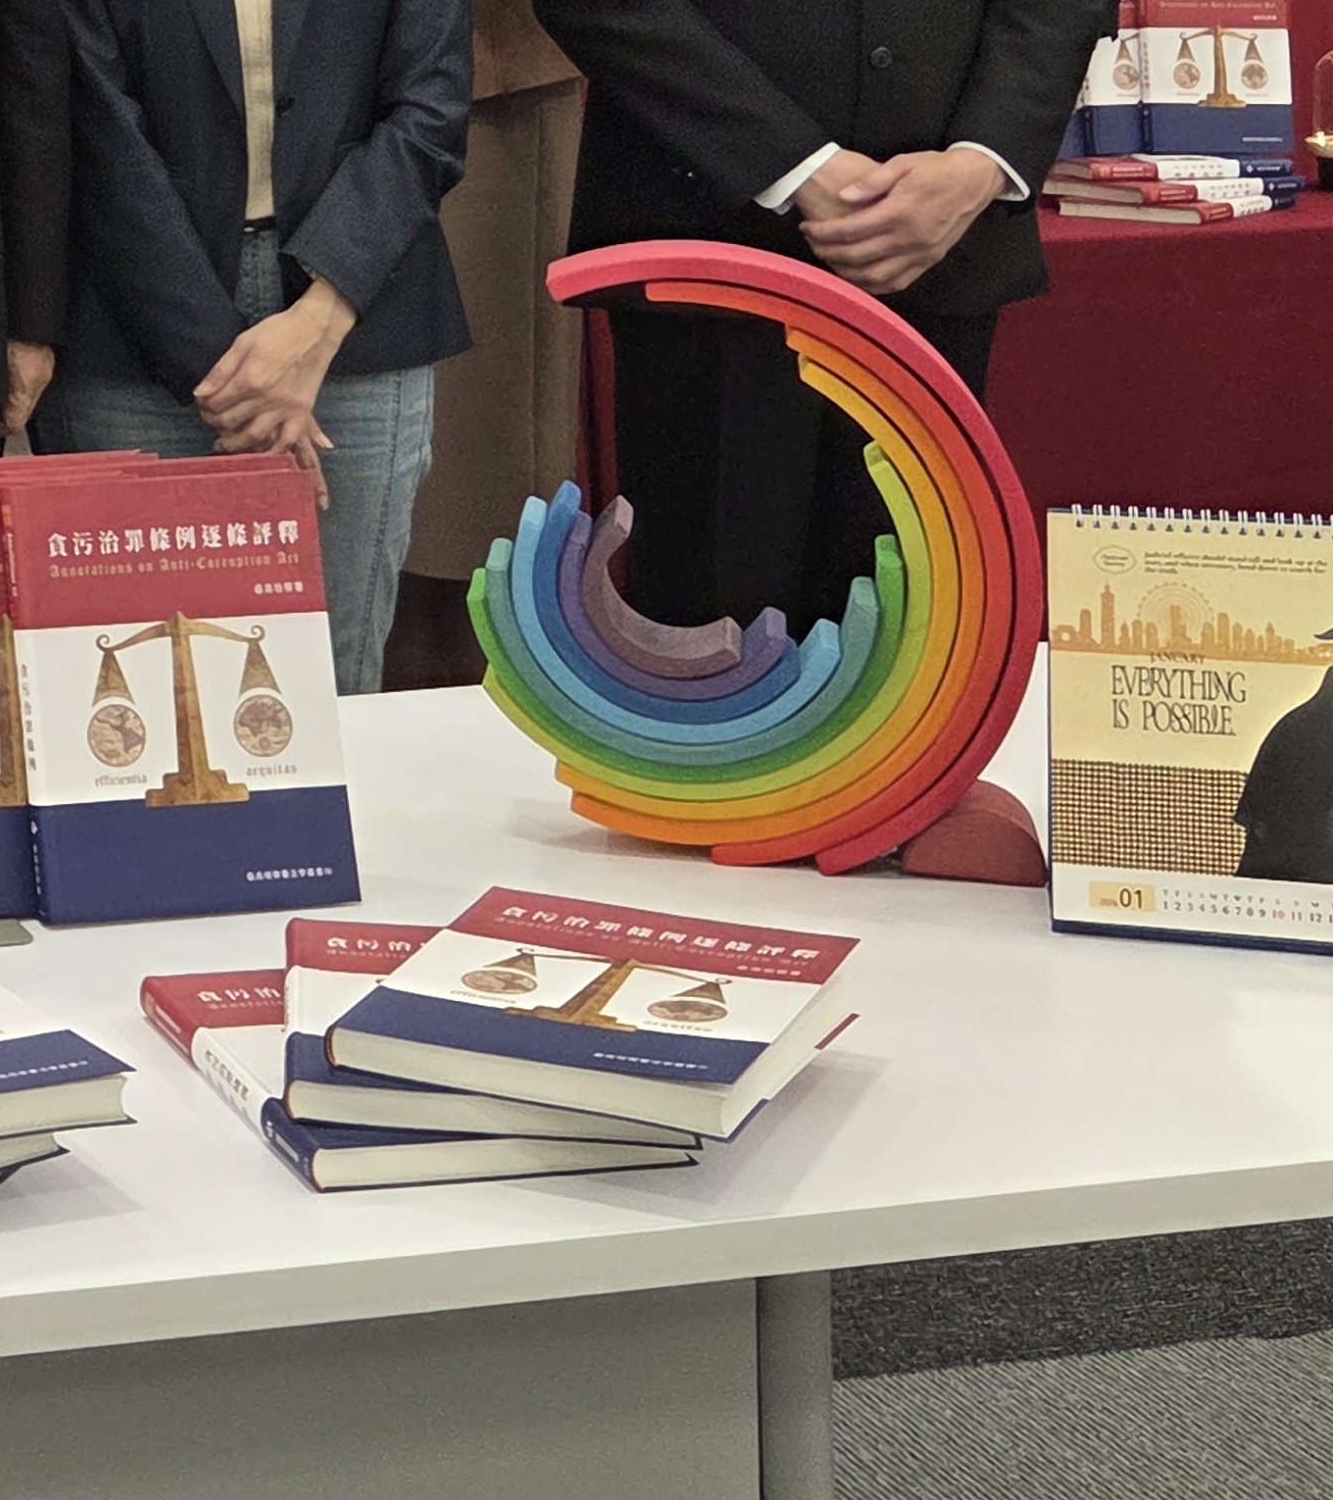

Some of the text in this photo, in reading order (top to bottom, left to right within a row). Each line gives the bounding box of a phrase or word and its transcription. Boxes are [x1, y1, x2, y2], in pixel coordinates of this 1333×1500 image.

[47, 520, 299, 557] 貪污治罪條例逐條評釋
[49, 562, 133, 579] Annotations
[1111, 665, 1247, 703] EVERYTHING
[1112, 698, 1237, 737] IS POSSIBLE
[1118, 887, 1143, 910] 01
